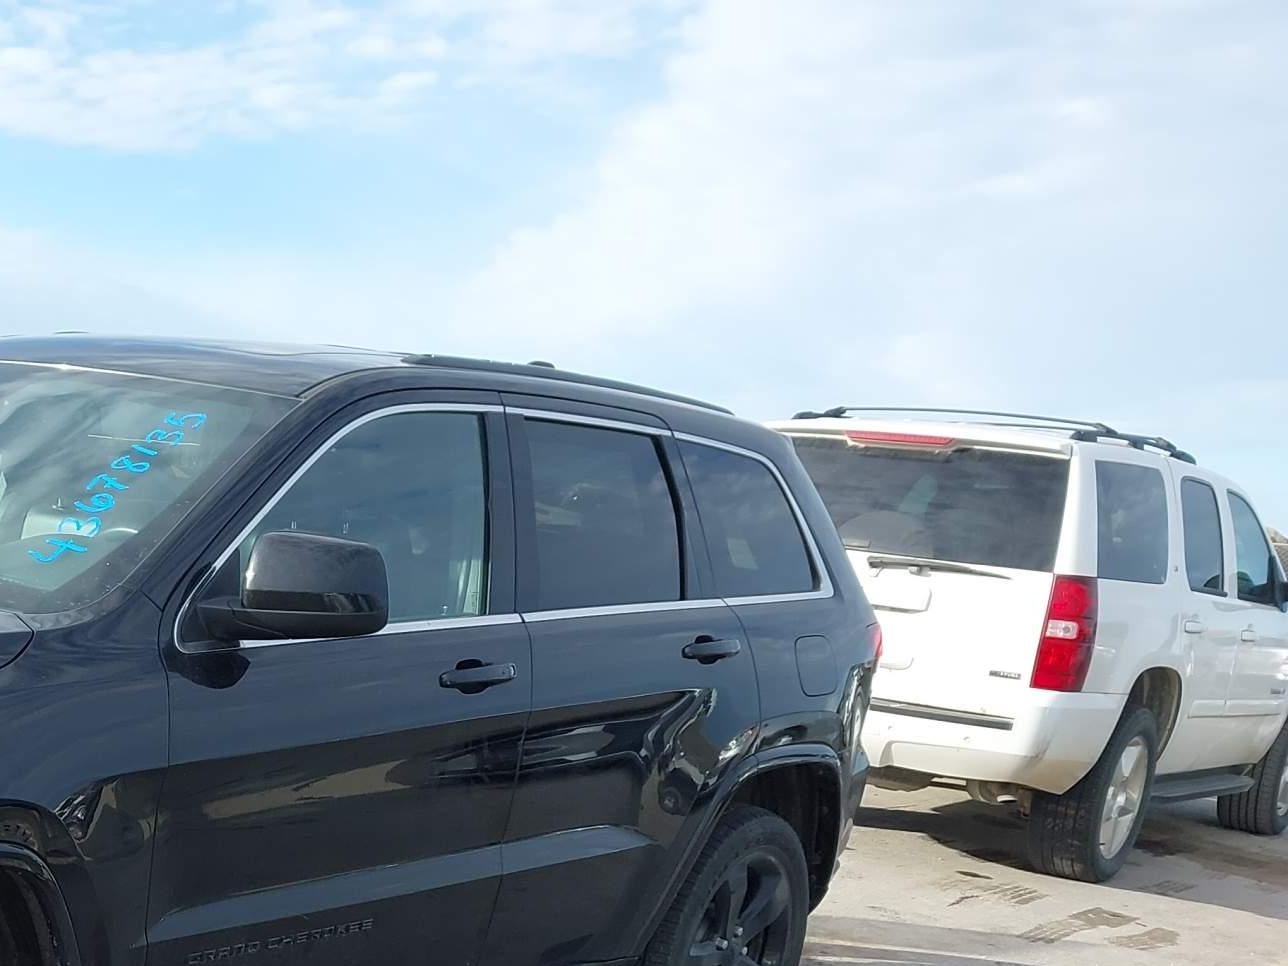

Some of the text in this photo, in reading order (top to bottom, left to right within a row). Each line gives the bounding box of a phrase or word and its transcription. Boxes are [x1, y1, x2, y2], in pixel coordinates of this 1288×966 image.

[28, 411, 207, 563] 43678135
[187, 918, 374, 965] GRAND CHEROKEE
